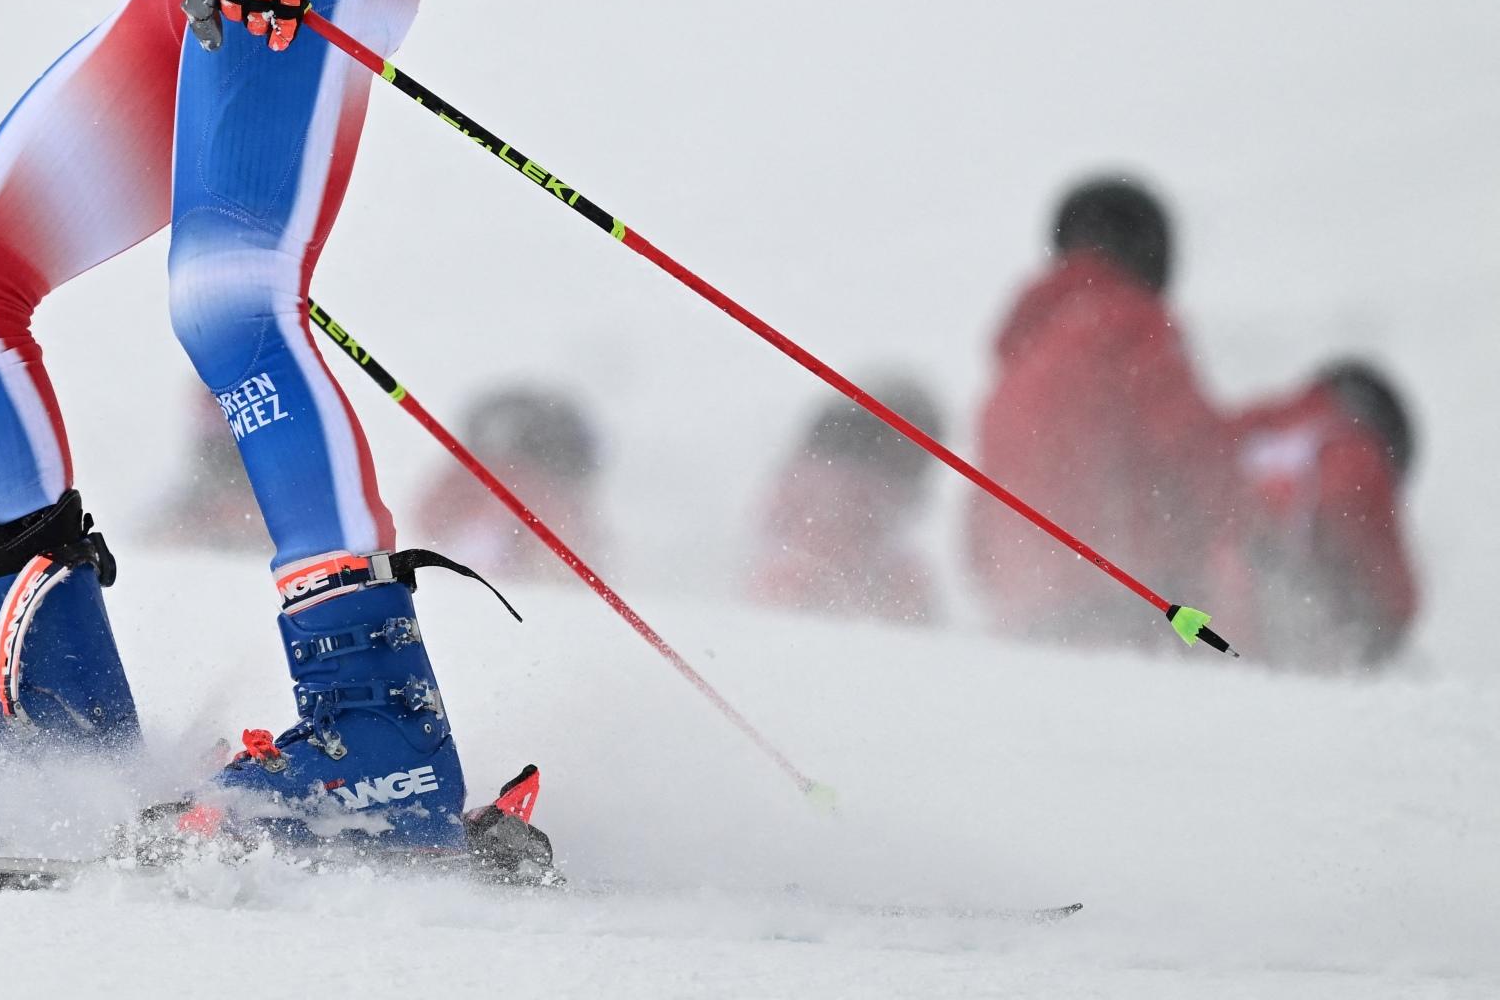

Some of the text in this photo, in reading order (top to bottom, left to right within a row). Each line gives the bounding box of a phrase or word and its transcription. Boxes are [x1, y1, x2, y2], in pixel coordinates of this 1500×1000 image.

[499, 143, 580, 206] LEKI
[309, 304, 370, 365] LEKI
[2, 571, 49, 676] LANGE
